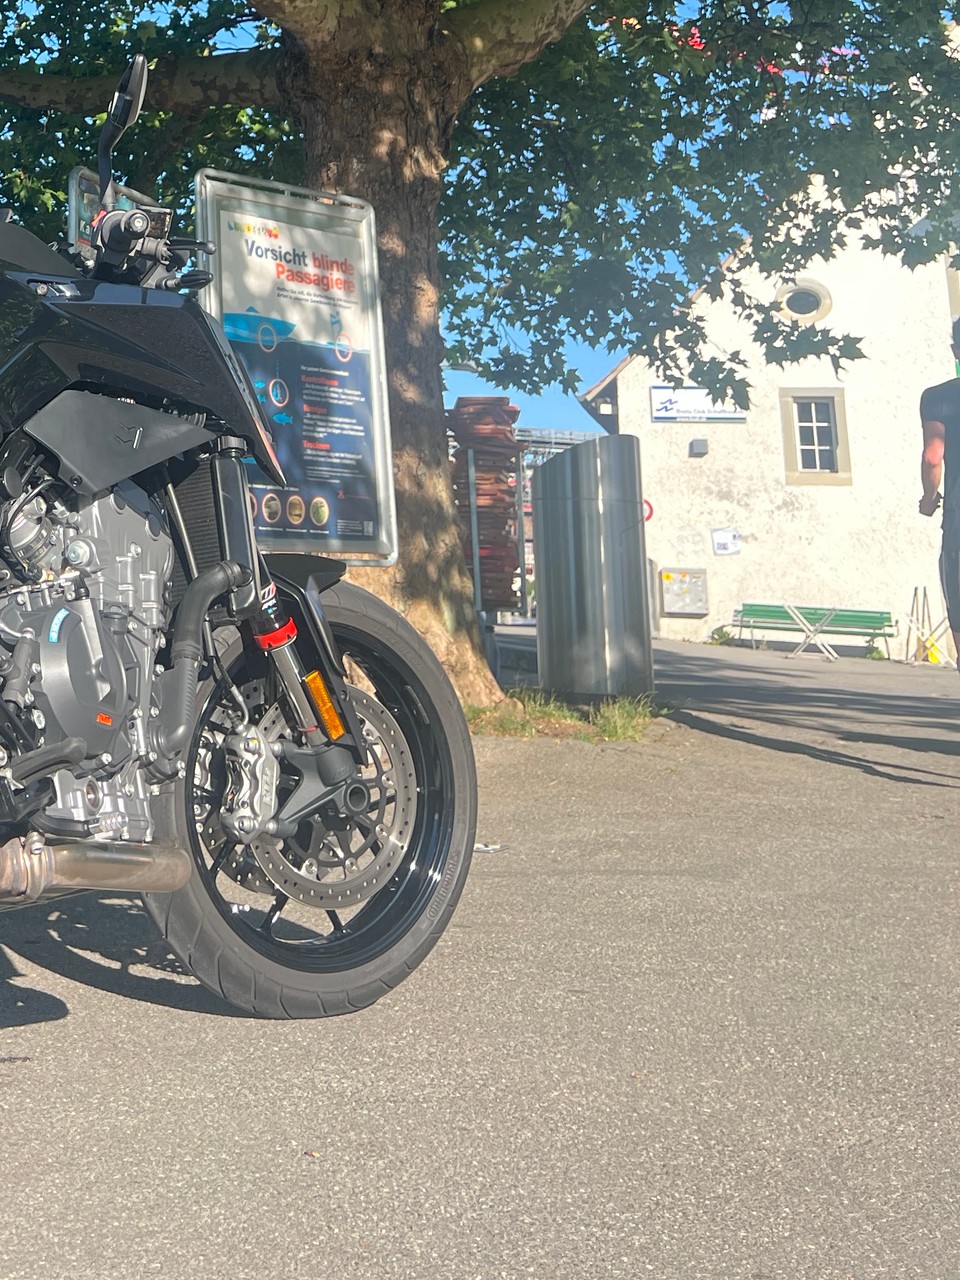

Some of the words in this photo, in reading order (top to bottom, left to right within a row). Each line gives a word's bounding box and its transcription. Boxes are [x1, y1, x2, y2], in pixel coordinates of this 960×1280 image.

[245, 238, 308, 267] Vorsicht
[311, 252, 354, 276] blinde
[275, 262, 355, 293] Passagiere
[426, 859, 458, 920] Continental
